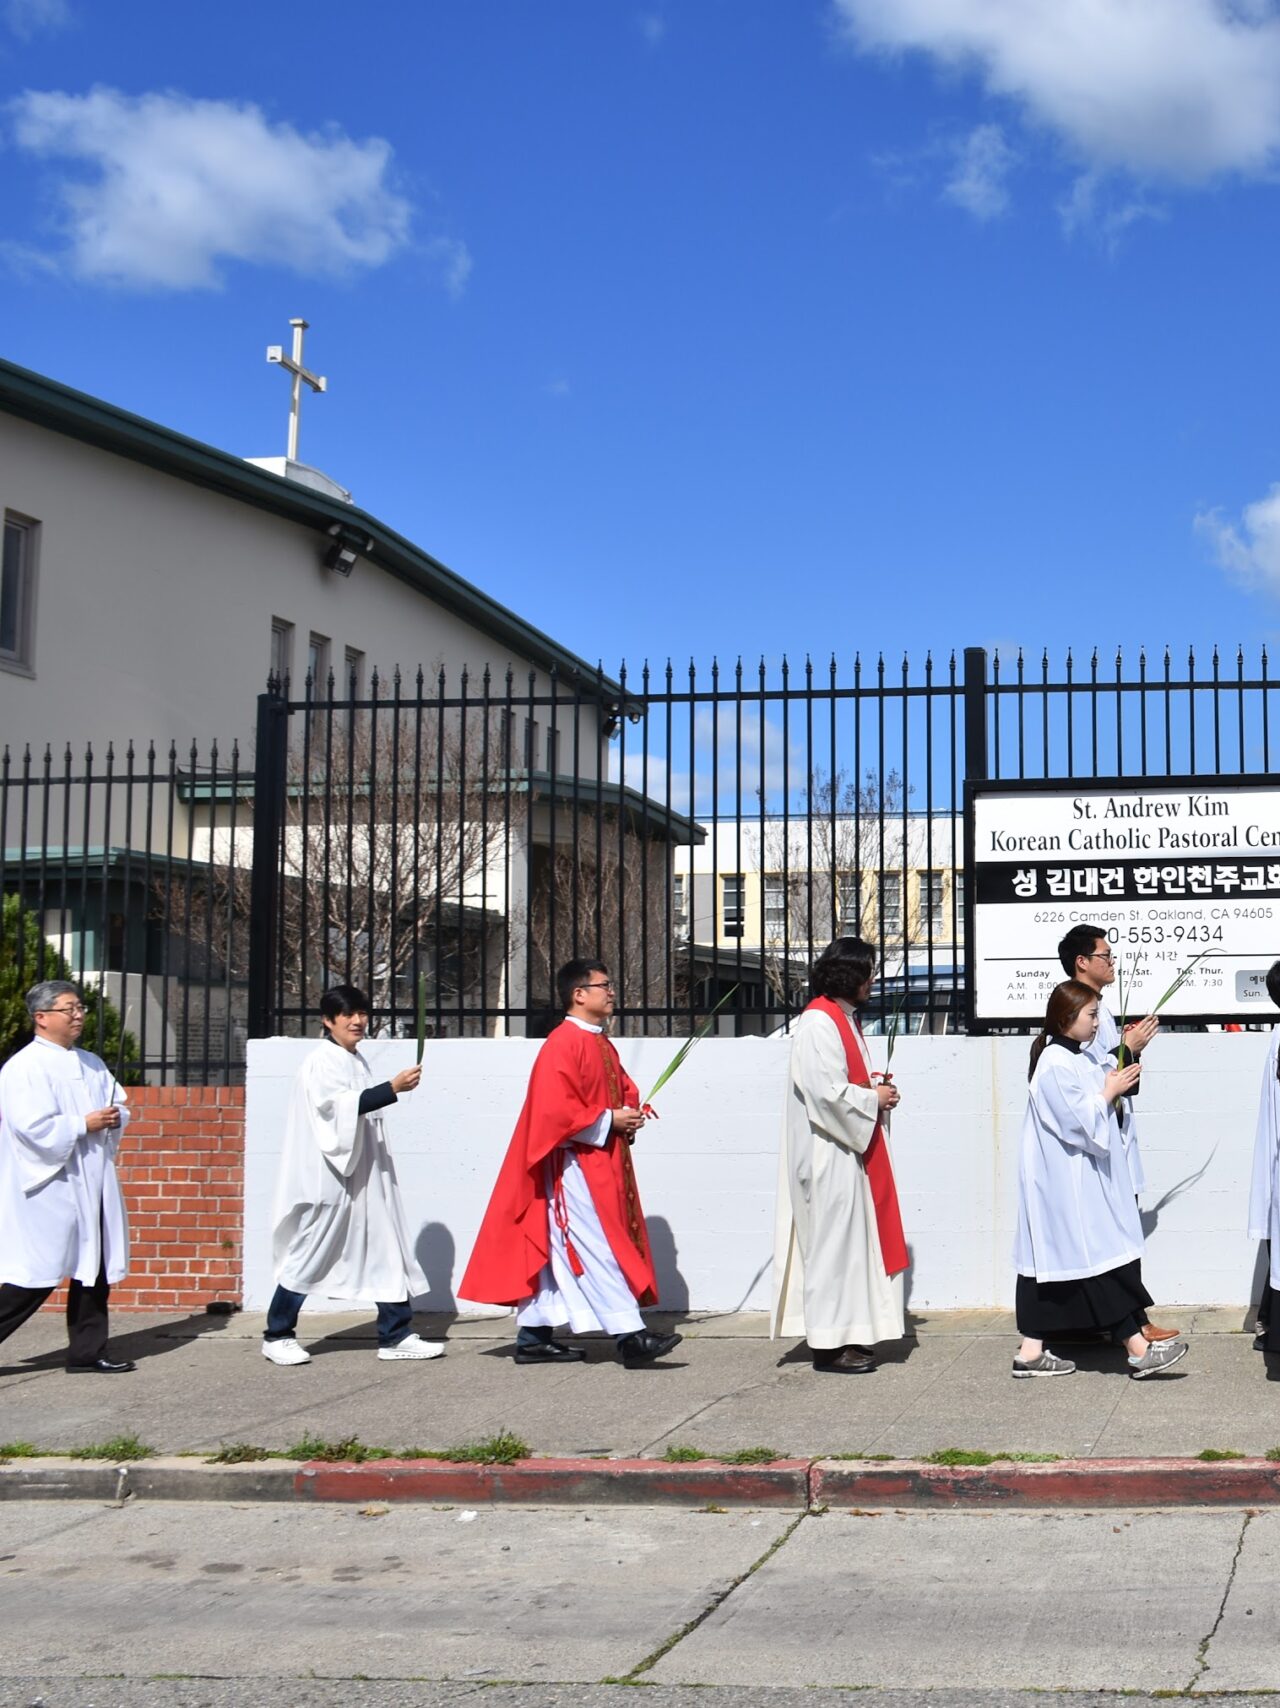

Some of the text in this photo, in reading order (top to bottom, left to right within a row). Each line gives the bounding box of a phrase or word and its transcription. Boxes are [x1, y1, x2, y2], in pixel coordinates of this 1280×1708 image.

[1072, 795, 1230, 819] St. Andrew Kim
[990, 830, 1061, 851] Korean
[1068, 827, 1151, 850] Catholic
[1158, 825, 1238, 849] Pastoral
[1011, 868, 1038, 898] 성
[1045, 866, 1125, 896] 김대건
[1033, 907, 1273, 923] 6226 Camden St. Oakland, CA 94605
[1107, 925, 1224, 943] 0-553-9434
[1125, 951, 1178, 962] 미사 시간
[1015, 970, 1050, 978] Sunday
[1135, 968, 1152, 976] Sat.
[1200, 967, 1224, 975] Thur.
